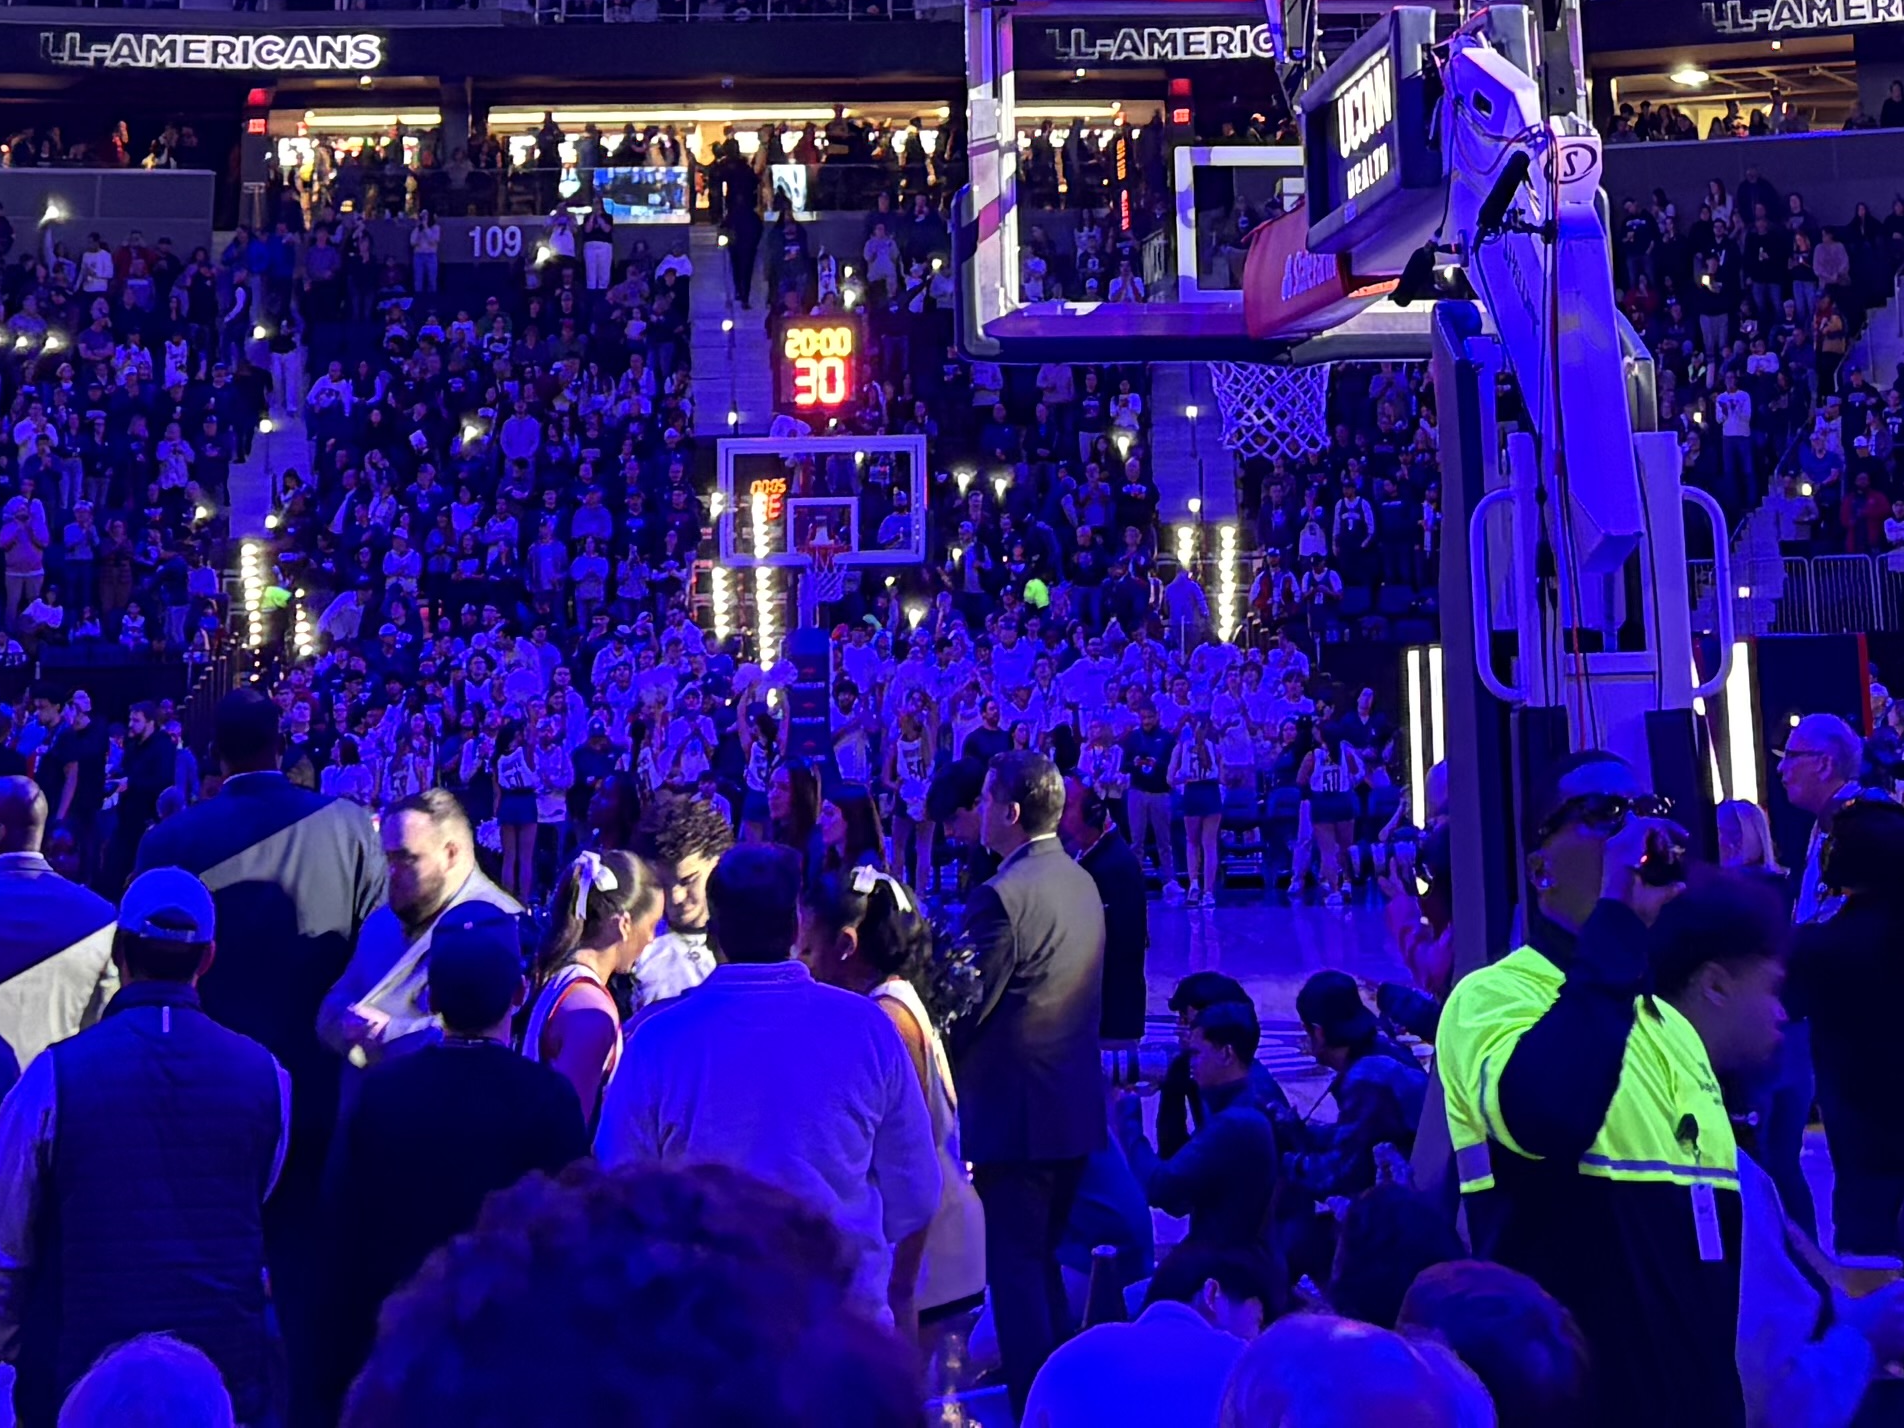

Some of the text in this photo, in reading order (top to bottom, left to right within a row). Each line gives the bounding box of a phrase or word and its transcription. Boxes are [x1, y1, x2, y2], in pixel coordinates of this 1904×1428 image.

[1337, 56, 1392, 159] UCONN
[1347, 142, 1389, 201] HEALTH
[467, 226, 522, 257] 109
[785, 327, 851, 359] 20:00
[794, 358, 845, 405] 30
